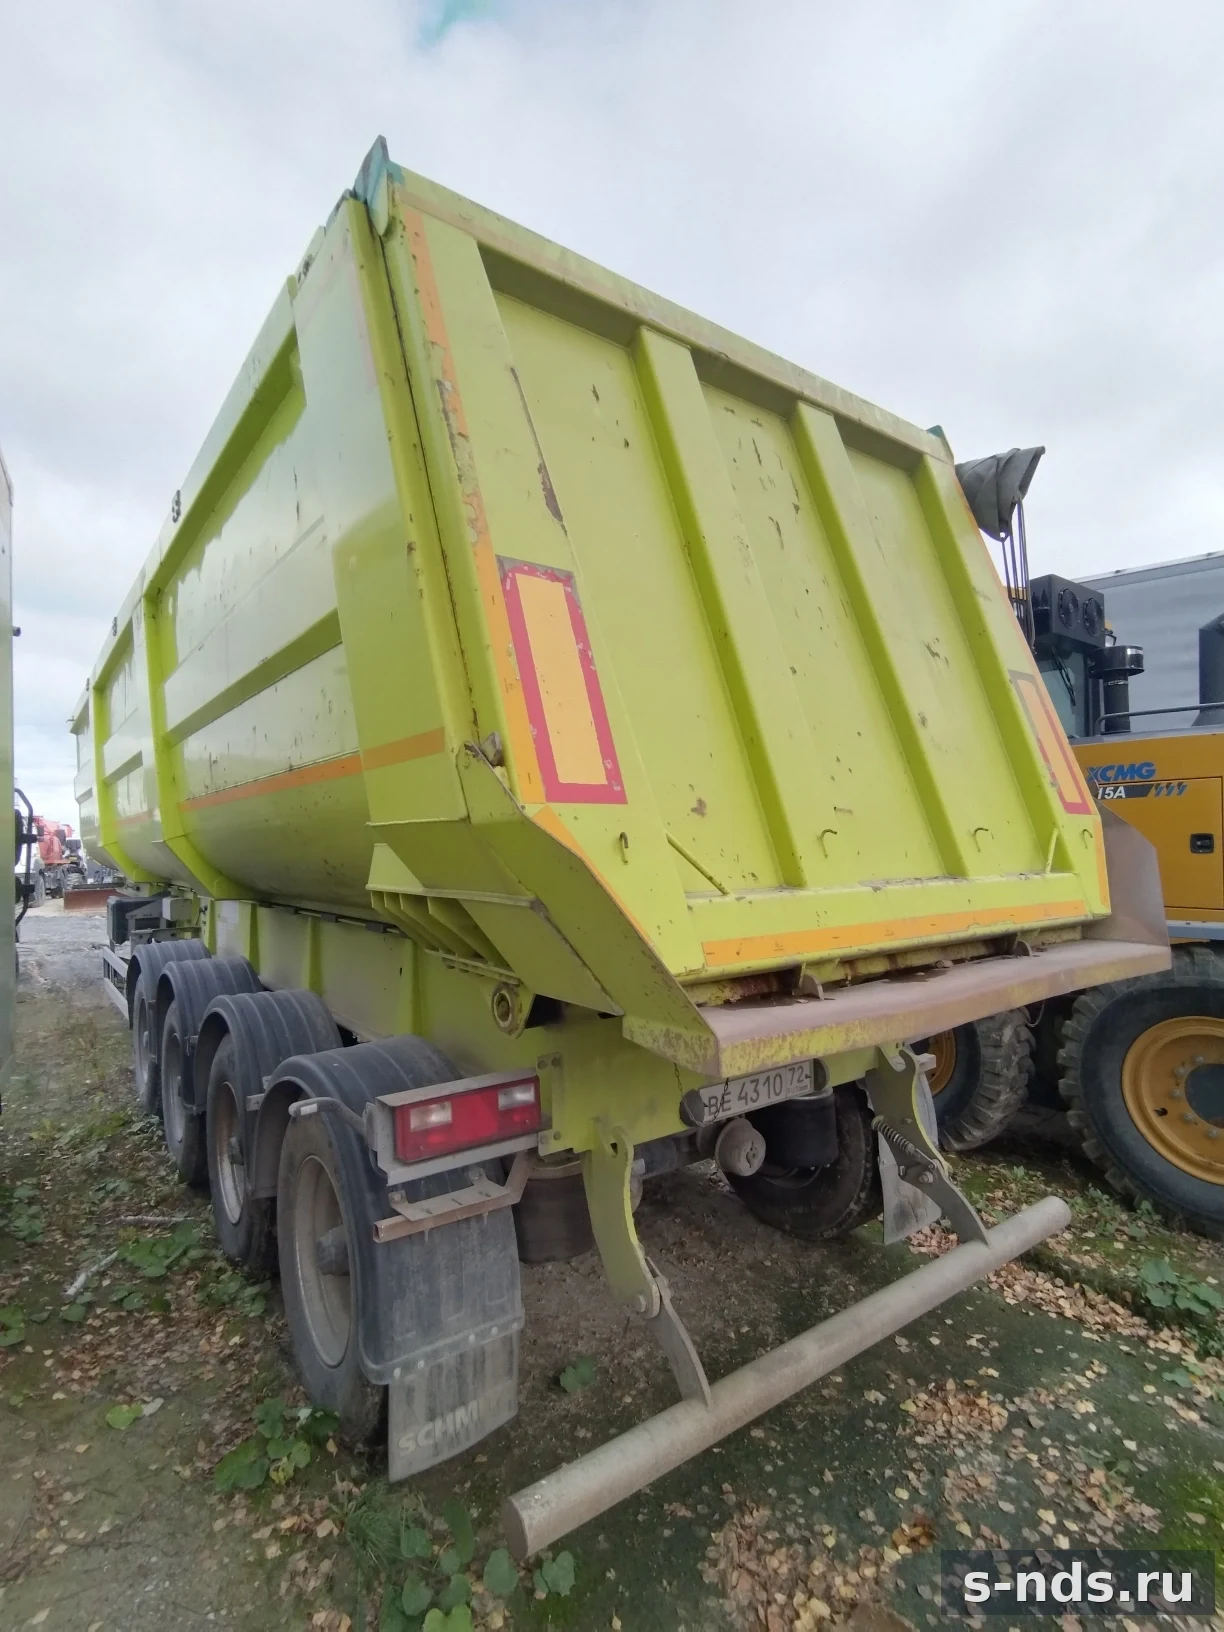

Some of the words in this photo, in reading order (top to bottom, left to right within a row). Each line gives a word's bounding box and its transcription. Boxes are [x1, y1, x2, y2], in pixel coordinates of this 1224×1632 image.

[1086, 762, 1156, 782] XCMG
[737, 1073, 783, 1106] 4310
[788, 1065, 805, 1086] 72
